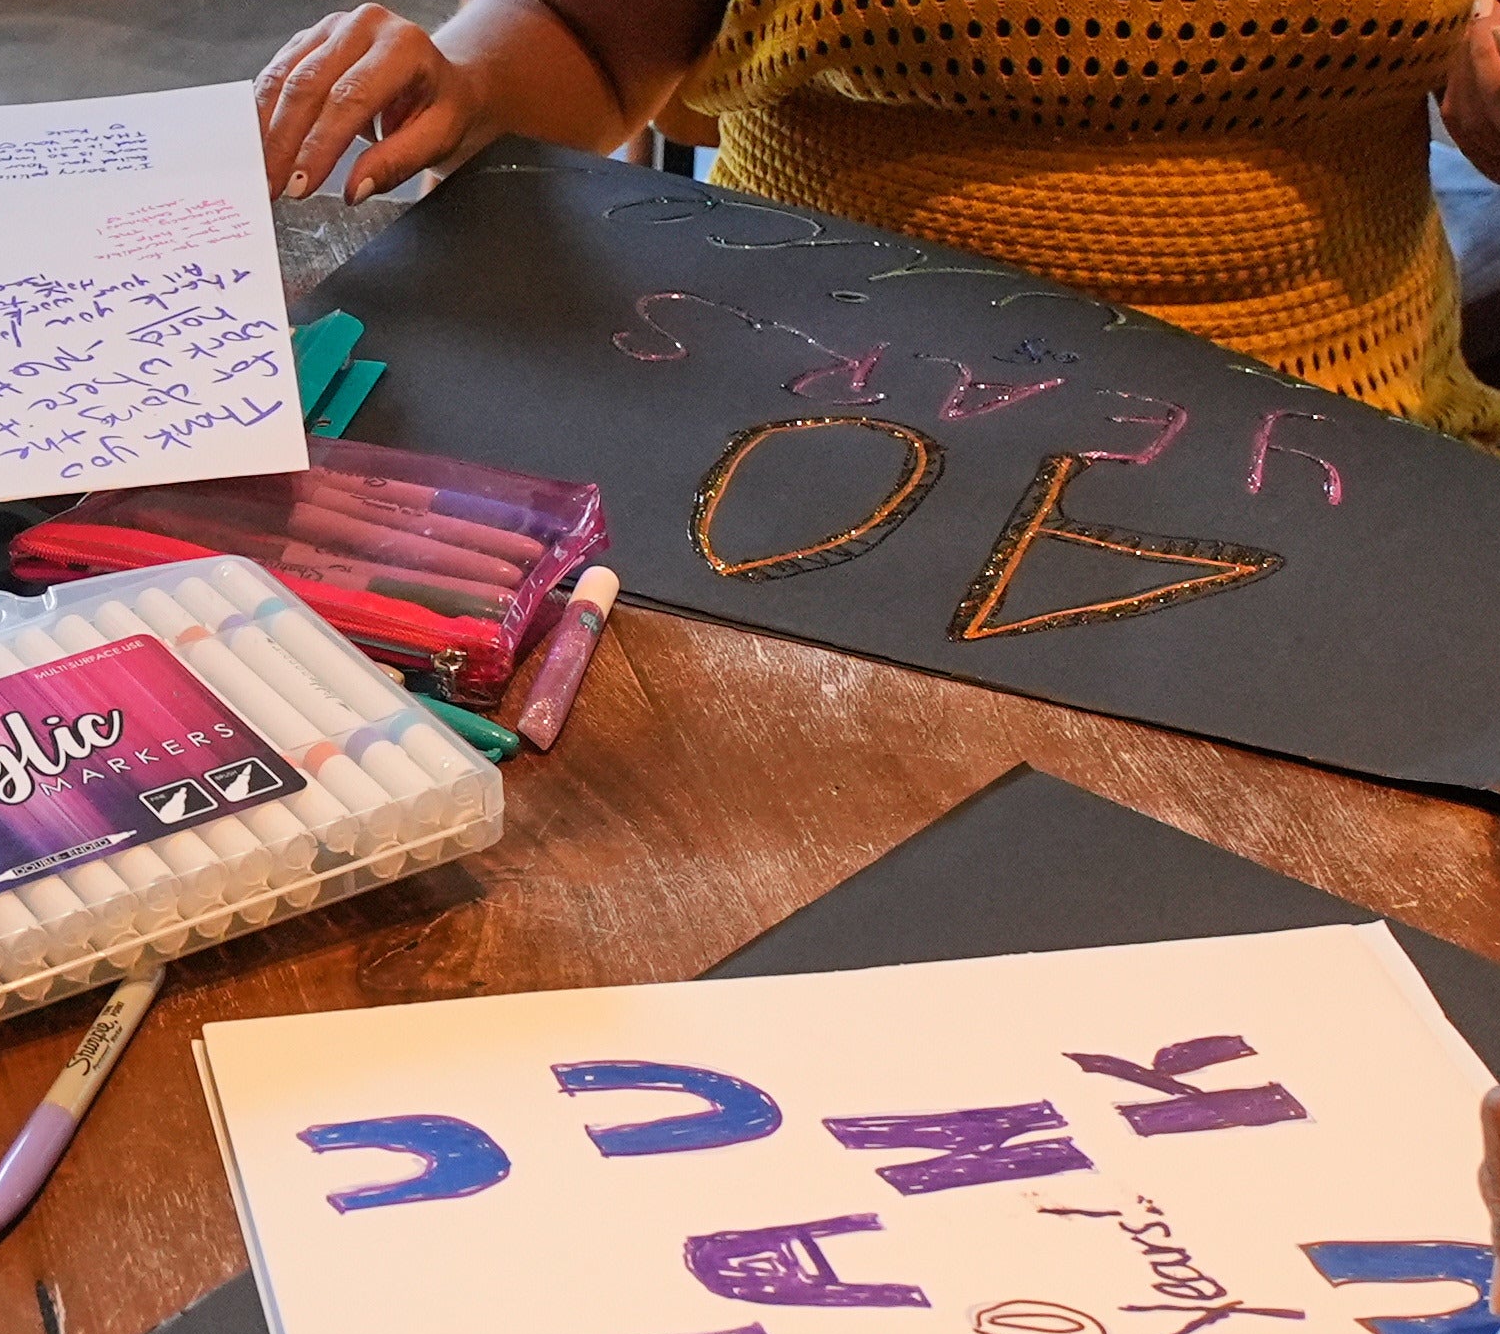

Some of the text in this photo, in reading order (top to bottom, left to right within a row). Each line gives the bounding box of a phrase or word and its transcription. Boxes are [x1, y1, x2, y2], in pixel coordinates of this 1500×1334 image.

[130, 268, 250, 311] Thank
[46, 302, 113, 327] you
[127, 307, 235, 347] hard
[182, 320, 277, 360] work
[28, 359, 172, 410] where
[212, 351, 278, 384] for
[78, 384, 201, 427] doing
[611, 290, 1342, 505] YEARS
[61, 398, 282, 478] Thank you
[688, 415, 1285, 642] 40
[34, 639, 146, 681] MULTI SURFACE USE
[38, 722, 237, 797] MARKERS
[66, 1020, 117, 1076] Sharpie
